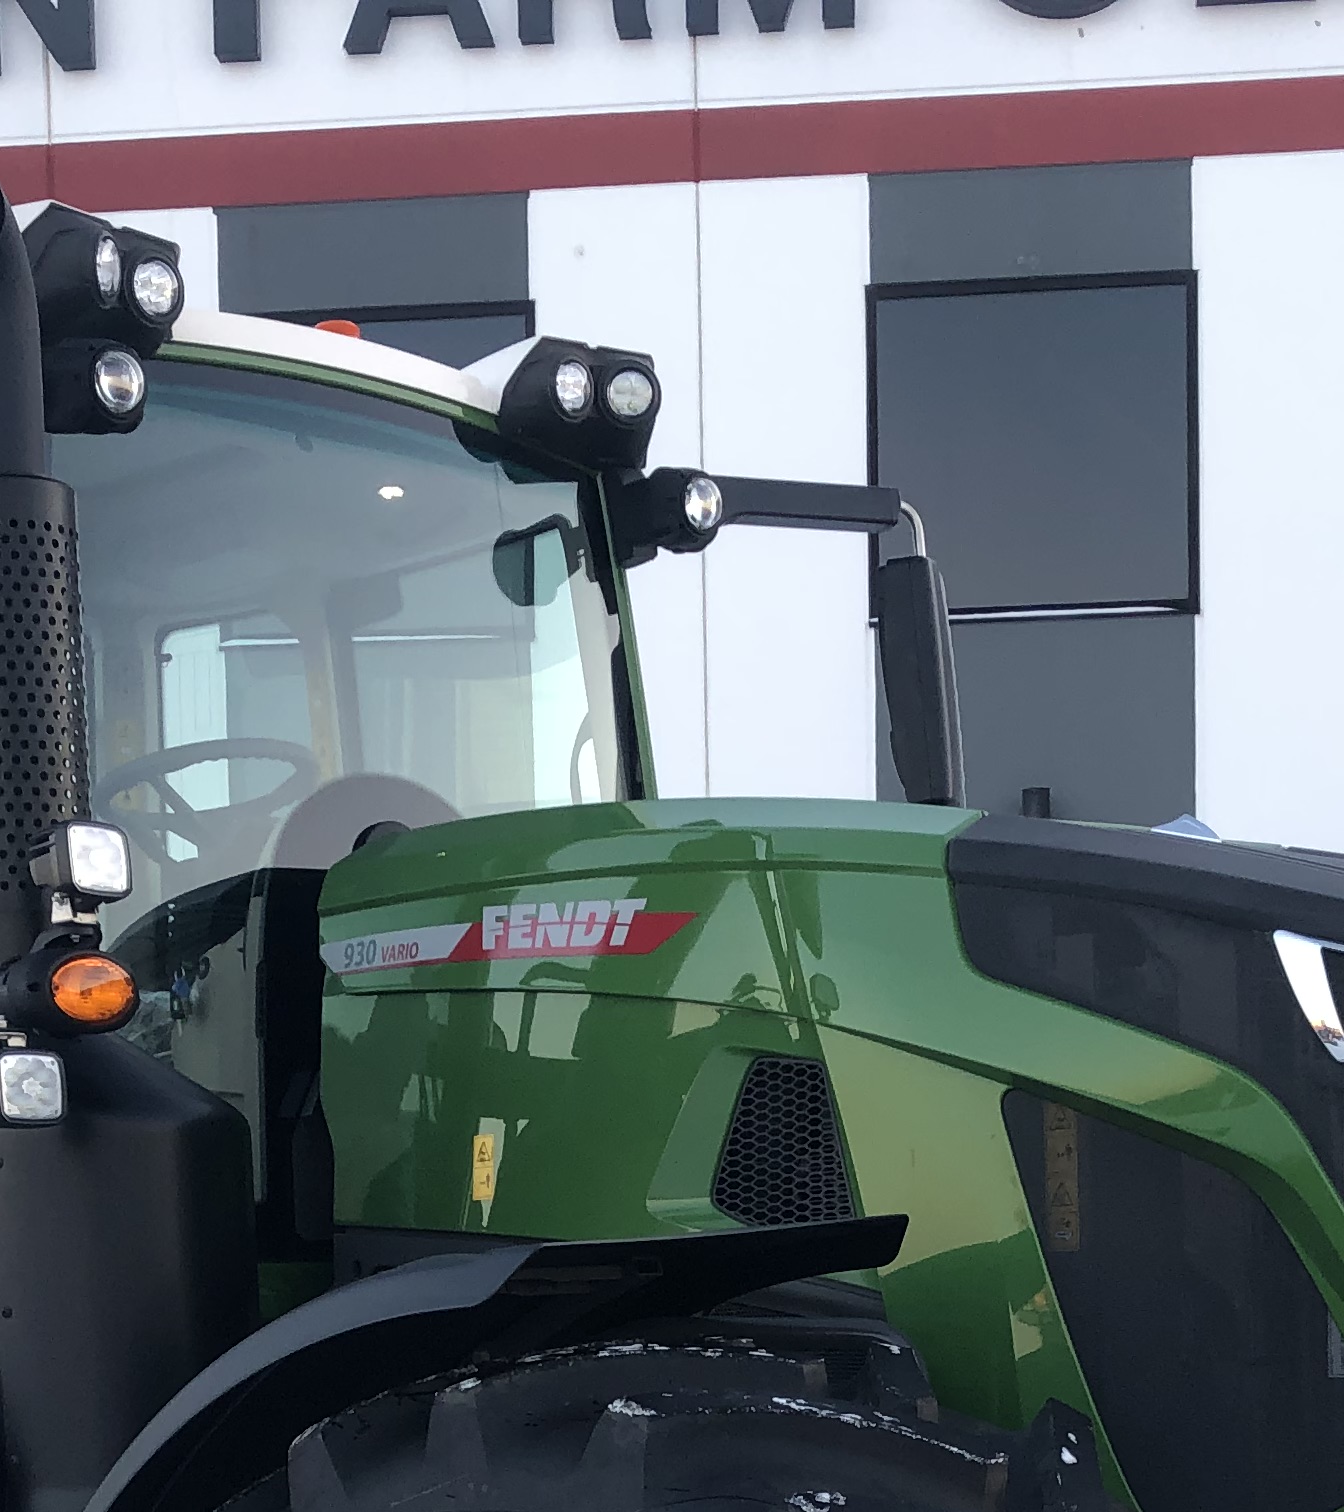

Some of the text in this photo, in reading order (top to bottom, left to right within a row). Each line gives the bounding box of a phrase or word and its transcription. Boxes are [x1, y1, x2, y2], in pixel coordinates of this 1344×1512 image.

[482, 897, 647, 951] FENDT
[343, 939, 420, 970] 930 VARIO
